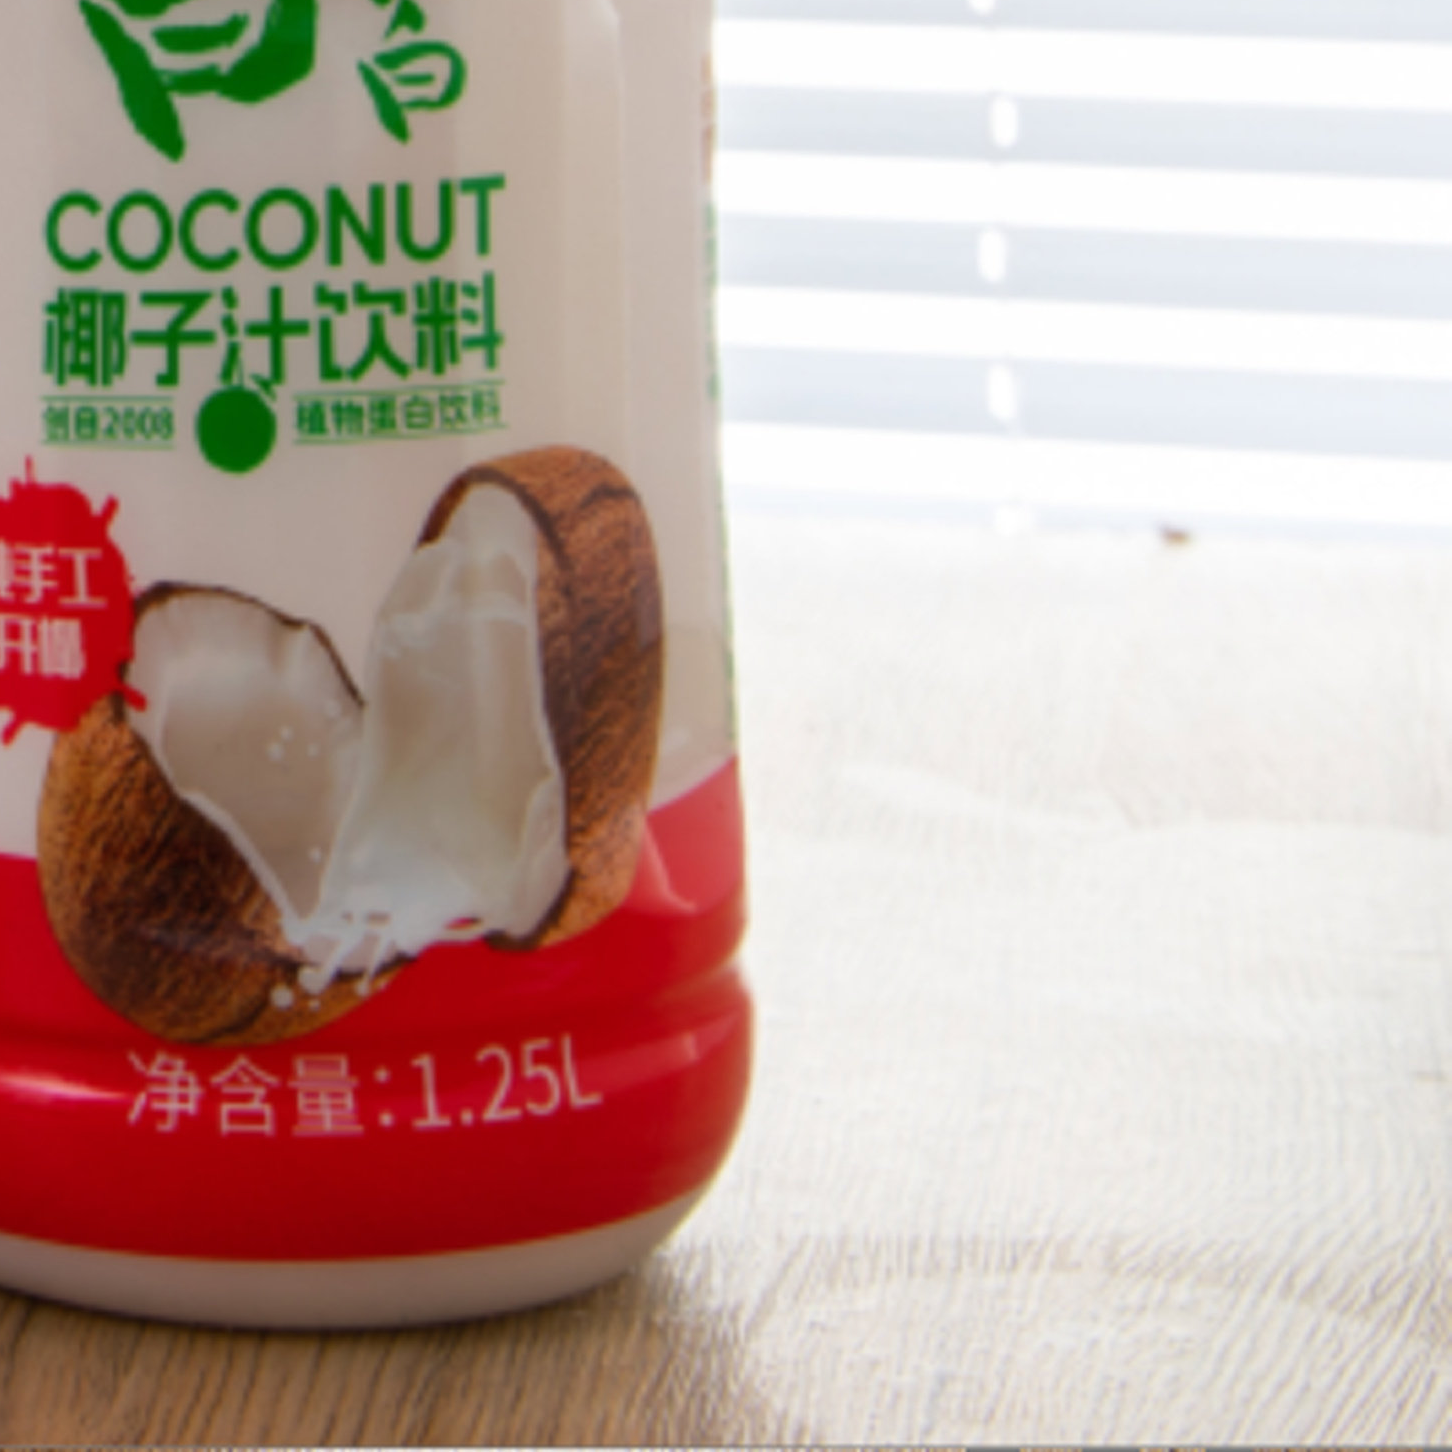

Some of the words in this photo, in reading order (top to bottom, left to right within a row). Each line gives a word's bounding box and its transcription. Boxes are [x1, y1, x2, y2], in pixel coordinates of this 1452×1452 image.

[43, 173, 505, 273] COCONUT
[43, 271, 504, 387] 椰子汁饮料
[295, 387, 502, 439] 植物蛋白饮料
